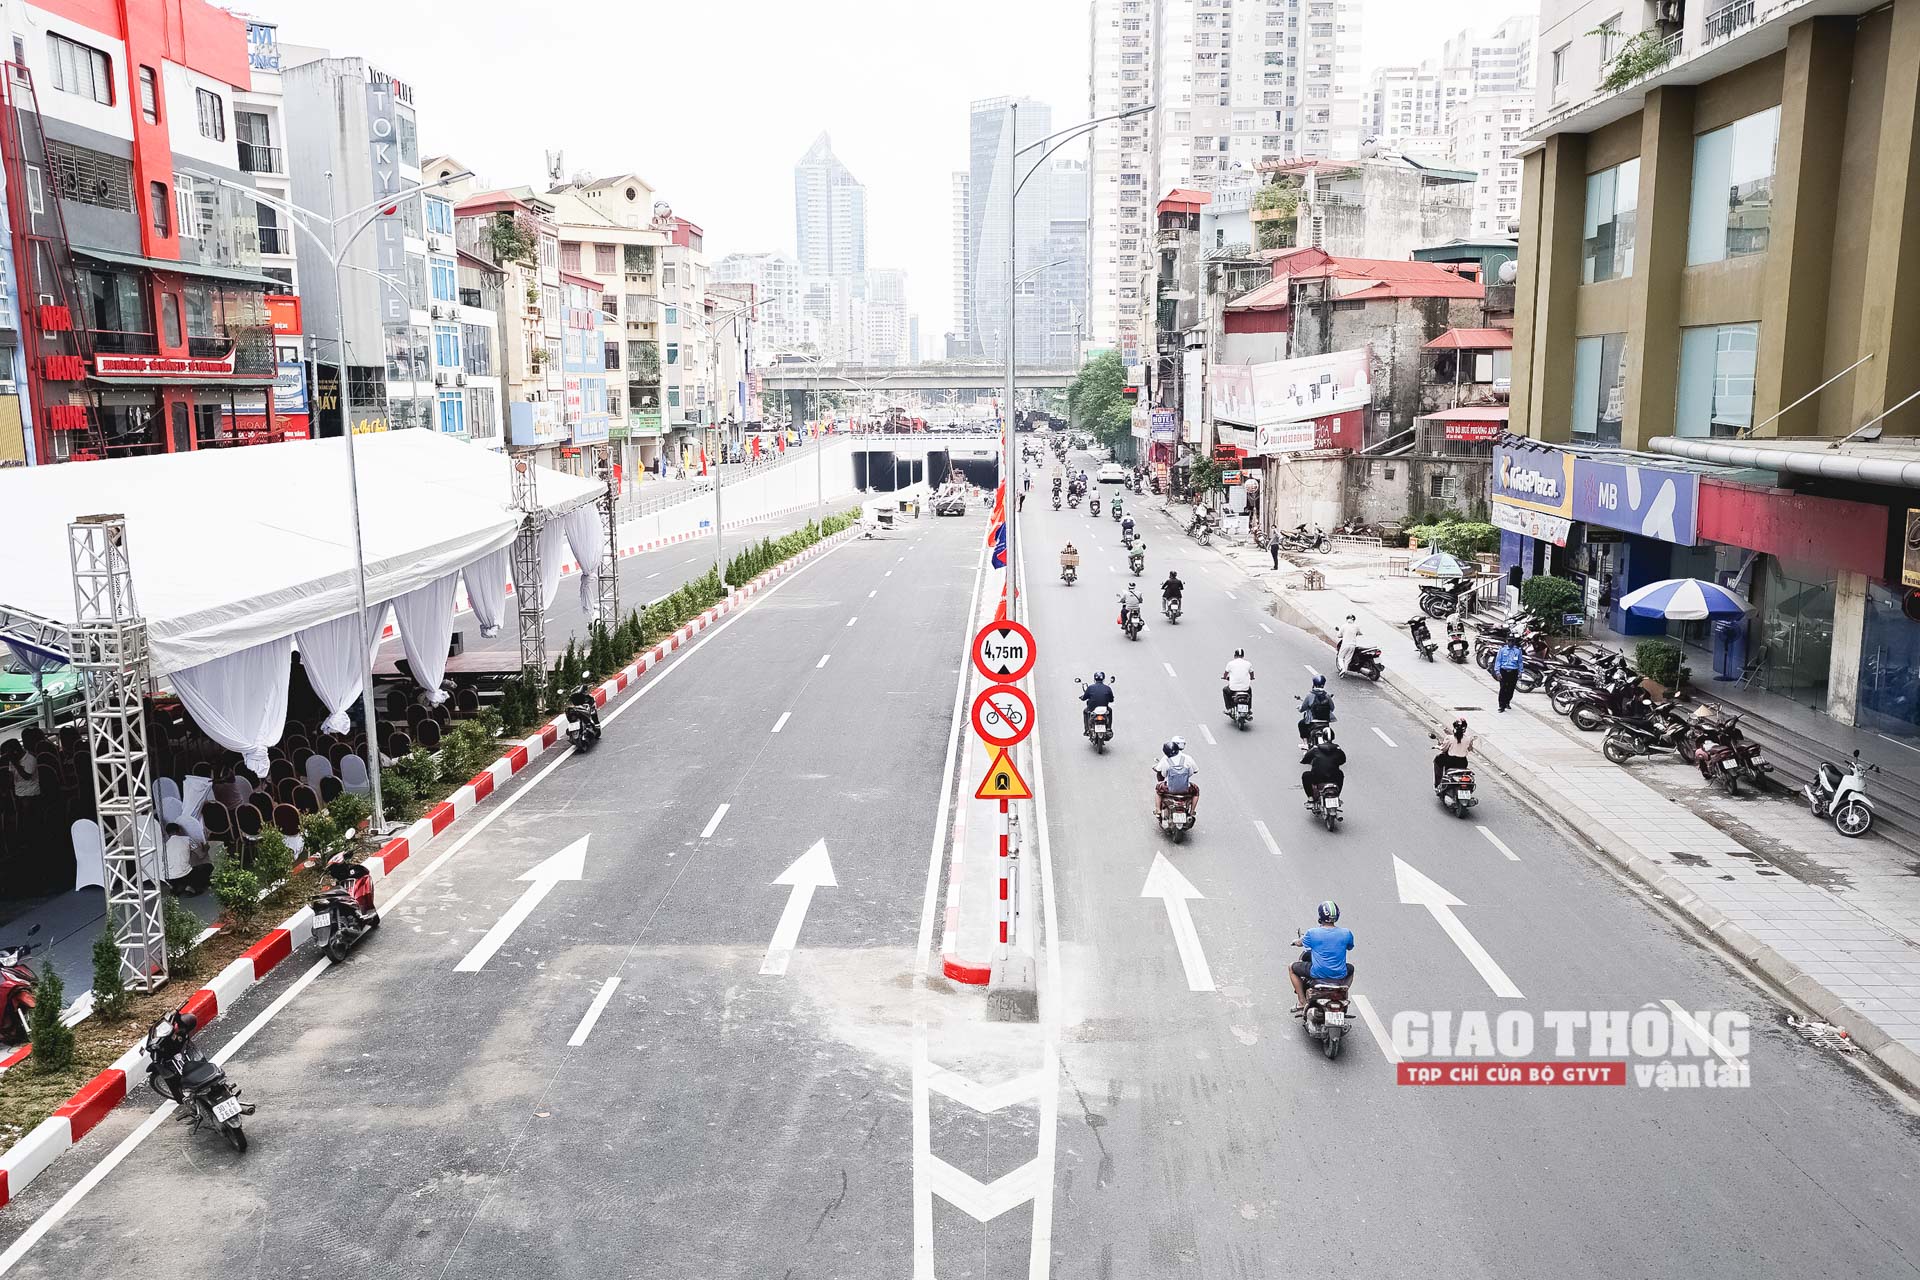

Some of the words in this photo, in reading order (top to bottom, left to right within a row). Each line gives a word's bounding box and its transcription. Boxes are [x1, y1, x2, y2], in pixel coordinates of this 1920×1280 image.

[1153, 415, 1174, 423] HOTEL
[1598, 482, 1618, 510] MB
[985, 640, 1023, 661] 4,75m
